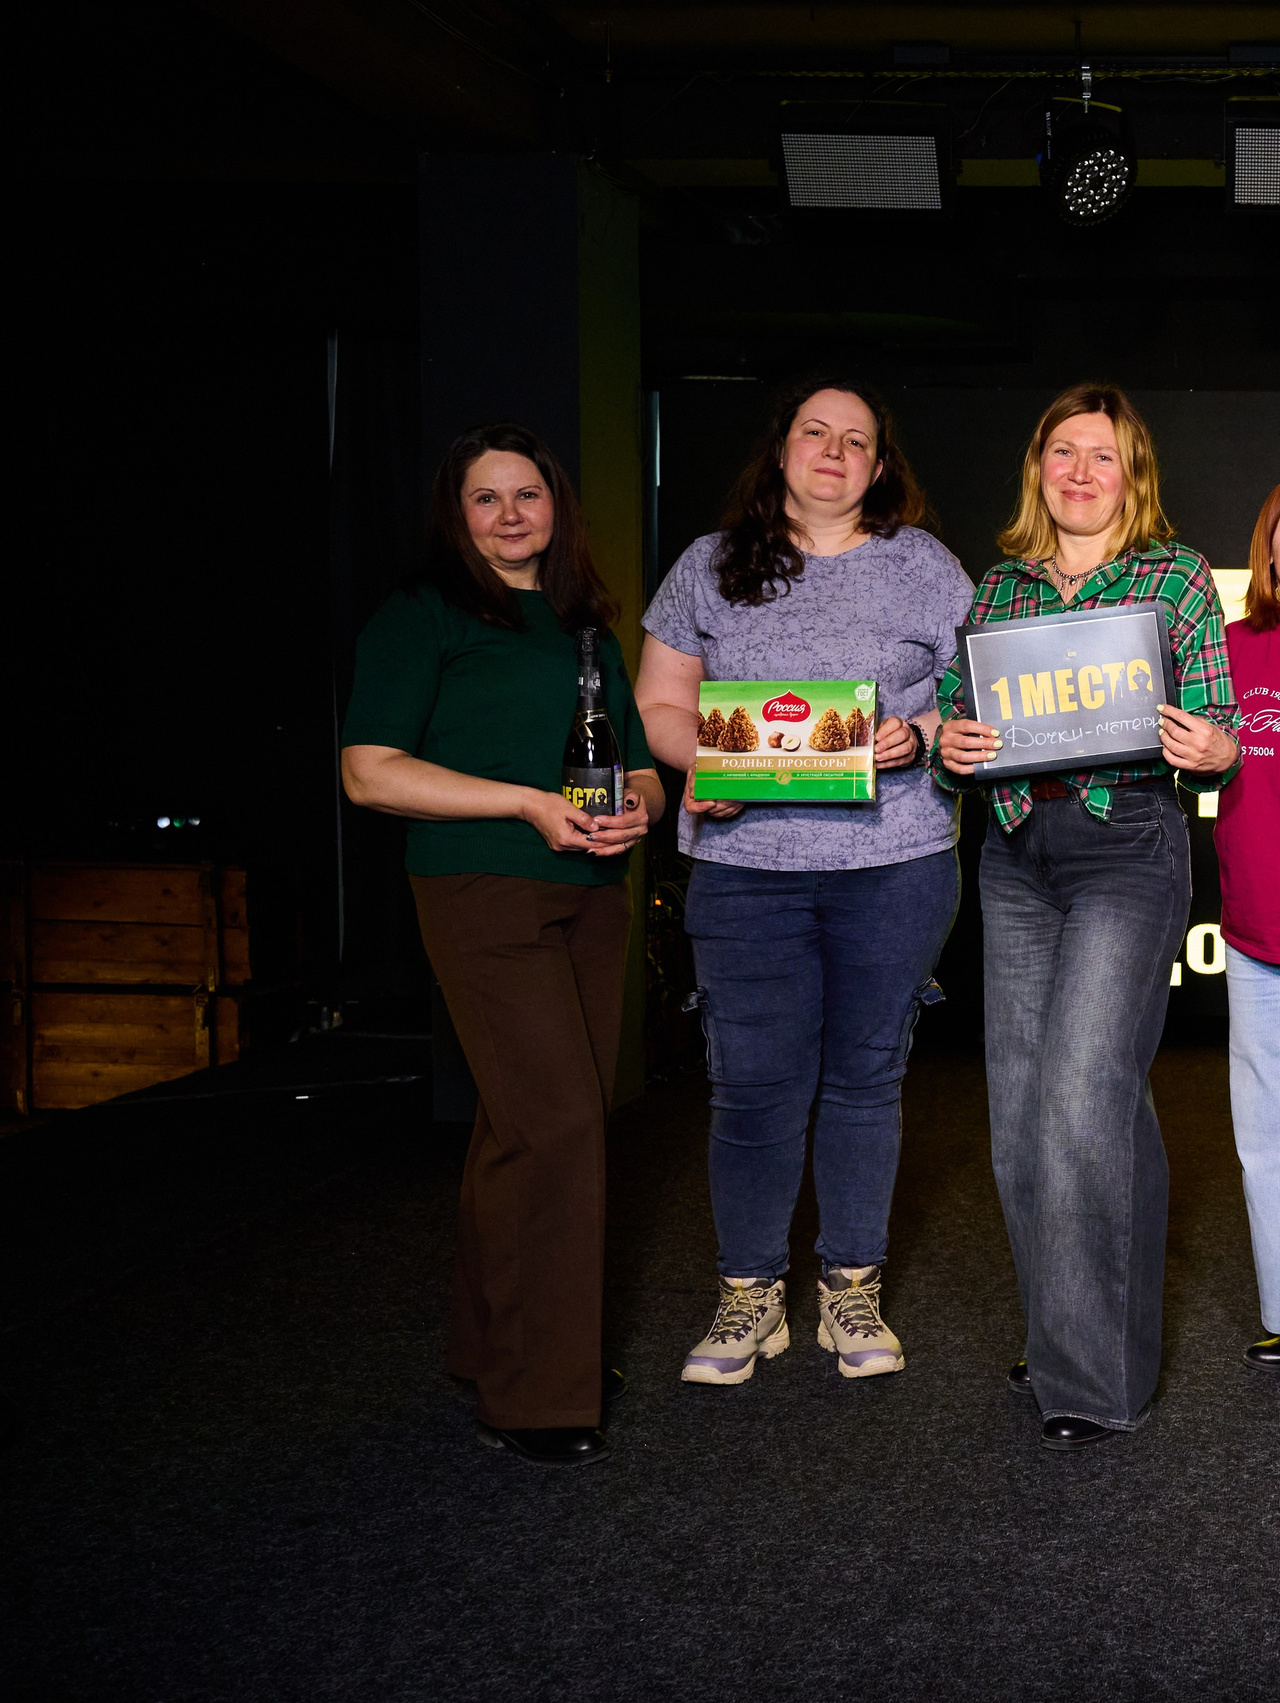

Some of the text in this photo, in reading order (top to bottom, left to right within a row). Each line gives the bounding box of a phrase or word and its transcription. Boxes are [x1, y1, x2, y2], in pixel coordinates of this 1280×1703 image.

[990, 659, 1153, 720] 1 МЕСТО
[1243, 687, 1270, 700] CLUB
[767, 701, 806, 714] Россия
[1248, 746, 1275, 757] 75004
[722, 758, 774, 768] РОДНЫЕ
